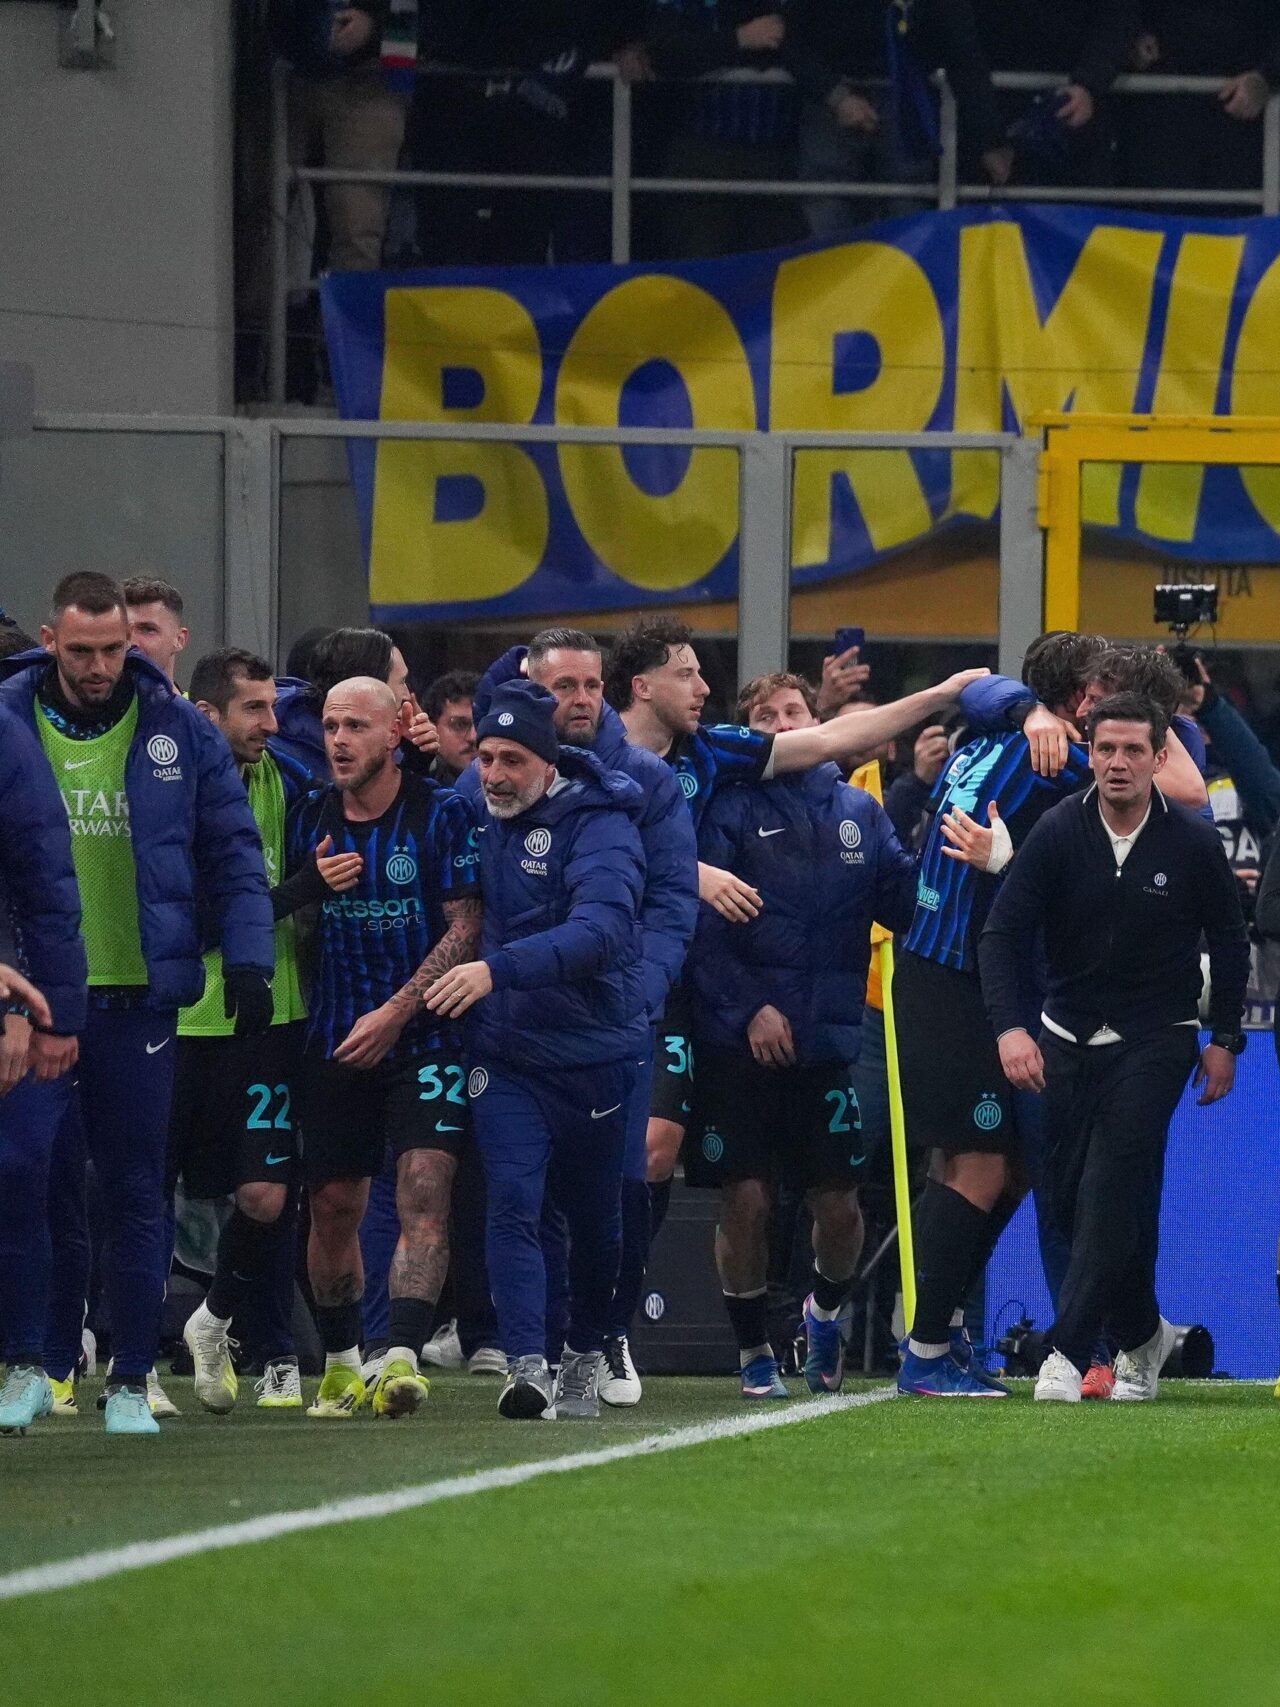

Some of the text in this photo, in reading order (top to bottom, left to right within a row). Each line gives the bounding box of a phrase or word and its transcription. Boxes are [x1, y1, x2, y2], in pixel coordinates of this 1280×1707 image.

[520, 859, 547, 871] QATAR
[418, 1063, 467, 1106] 32
[246, 1083, 292, 1130] 22
